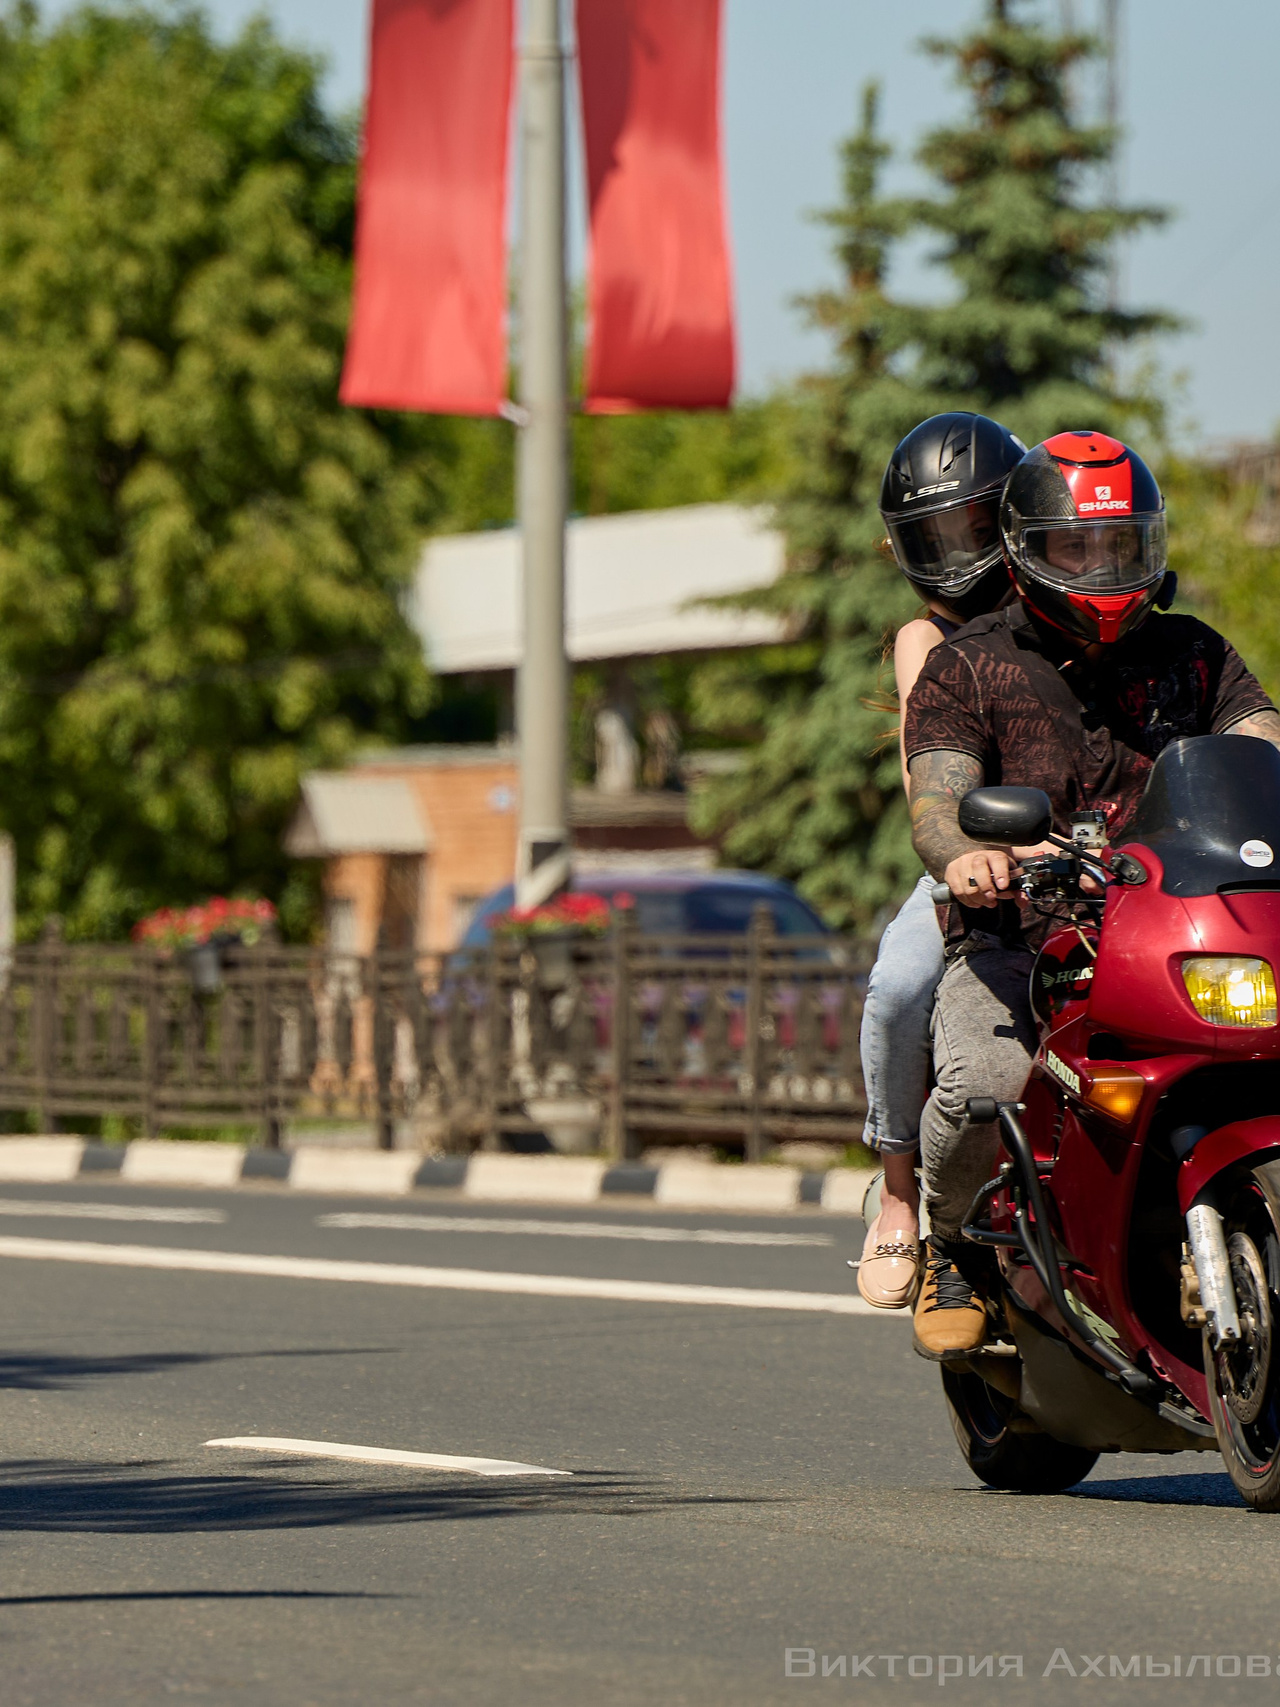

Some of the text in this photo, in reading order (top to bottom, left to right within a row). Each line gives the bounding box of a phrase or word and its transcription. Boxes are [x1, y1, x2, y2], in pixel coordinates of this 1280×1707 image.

[902, 480, 961, 503] LS2
[1078, 499, 1130, 513] SHARK
[1055, 966, 1095, 984] HON
[1046, 1050, 1081, 1094] HONDA
